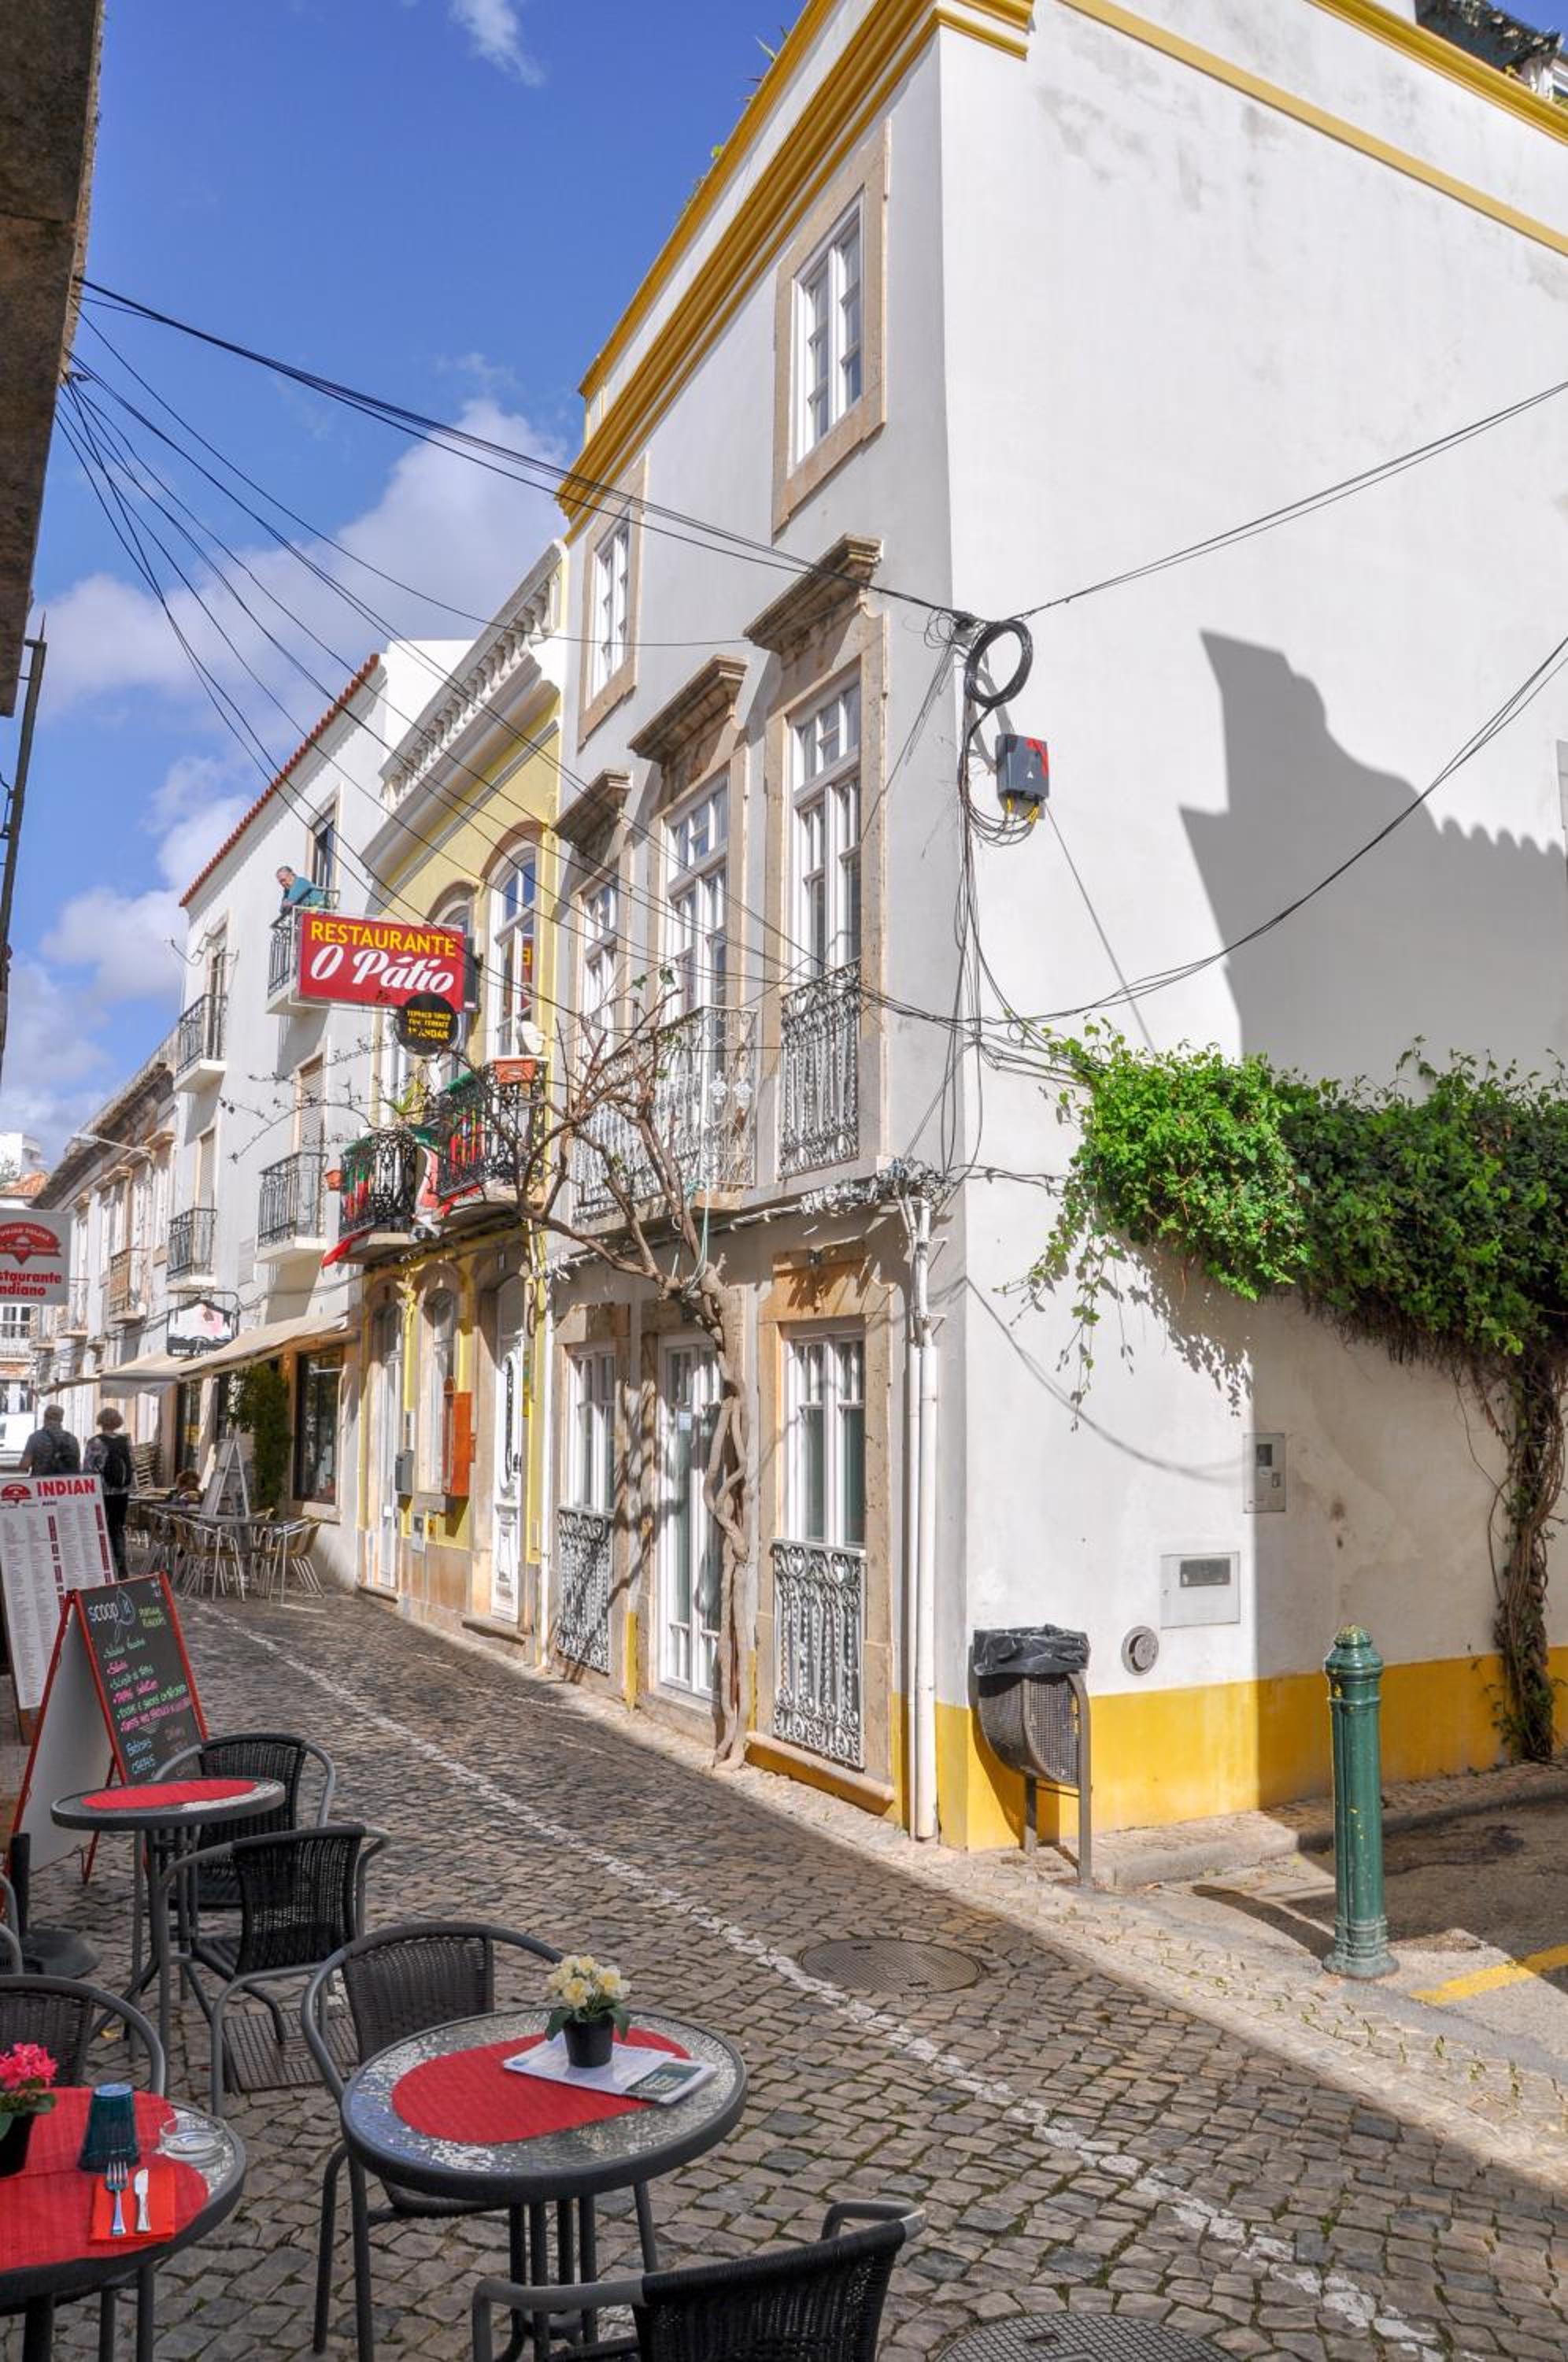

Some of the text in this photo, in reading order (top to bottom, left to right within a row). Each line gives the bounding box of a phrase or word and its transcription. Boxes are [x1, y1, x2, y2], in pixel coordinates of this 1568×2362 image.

[311, 920, 457, 957] RESTAURANTE
[310, 945, 454, 993] O Pátio
[36, 1479, 95, 1497] INDIAN
